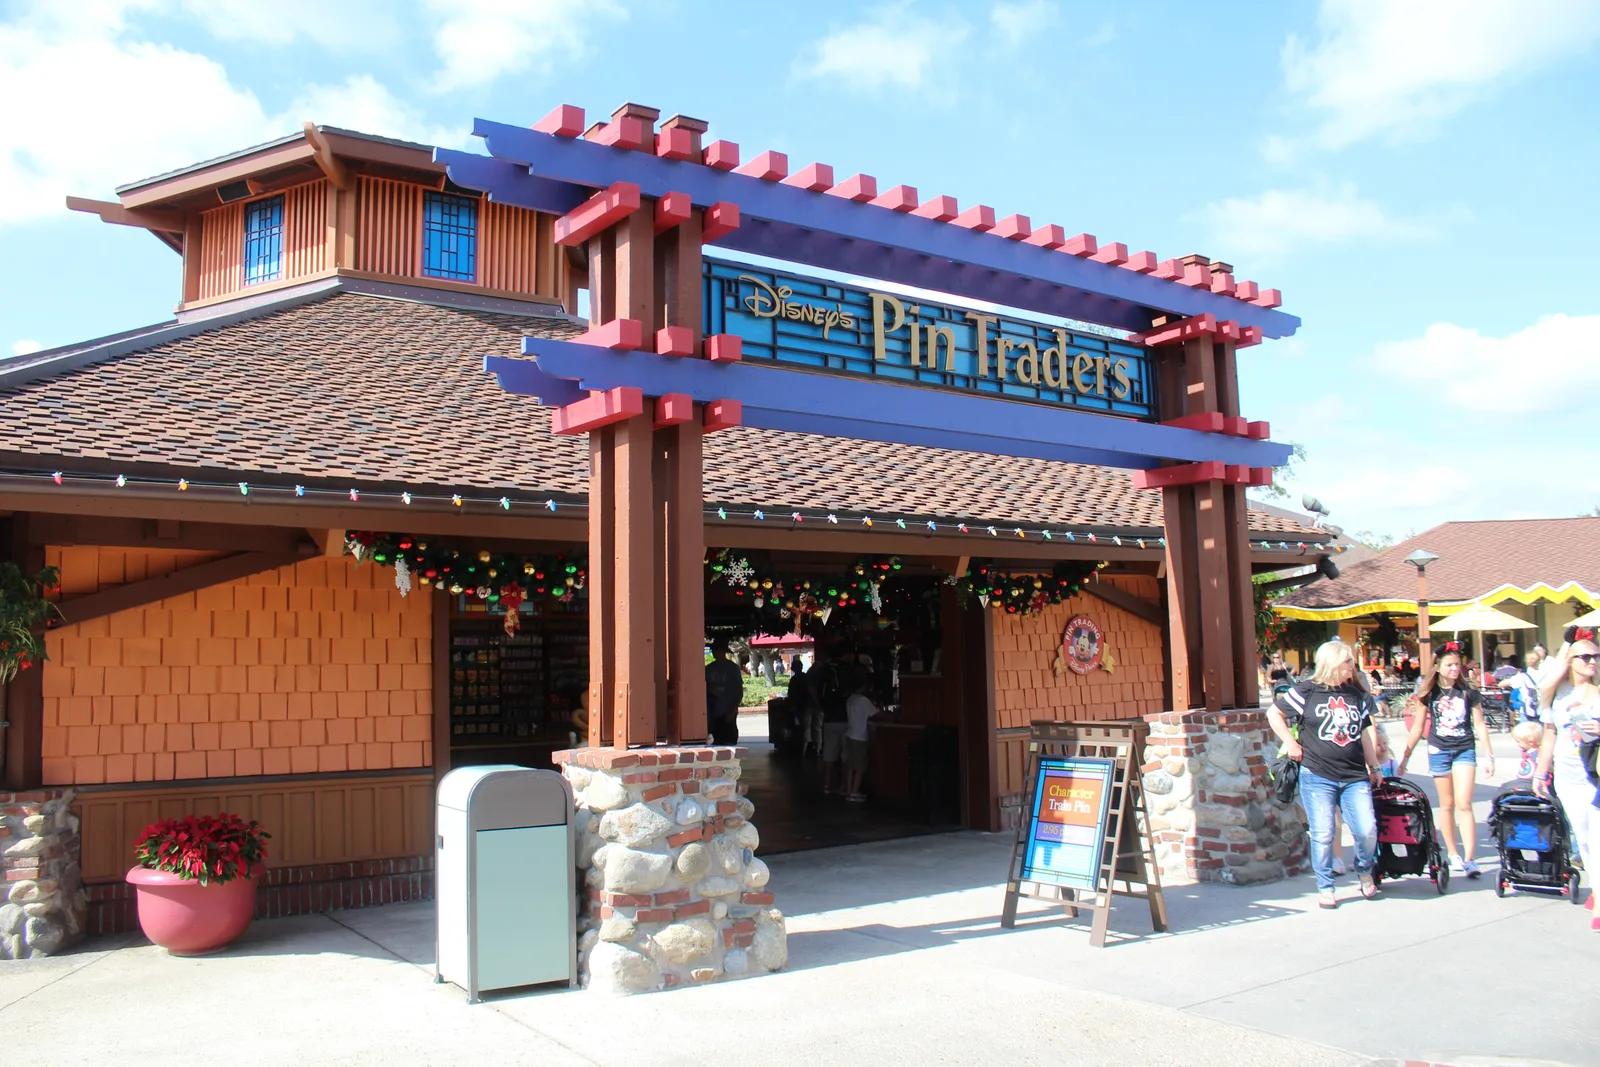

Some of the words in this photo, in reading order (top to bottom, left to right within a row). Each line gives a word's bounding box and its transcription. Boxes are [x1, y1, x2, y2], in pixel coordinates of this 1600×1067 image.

[868, 292, 956, 372] Pin
[965, 311, 1132, 400] Traders
[1065, 626, 1074, 641] PIN
[1073, 618, 1101, 640] TRADING
[1049, 784, 1095, 800] Character
[1049, 798, 1072, 812] Train
[1073, 800, 1091, 814] Pin
[1042, 823, 1059, 835] 2.95
